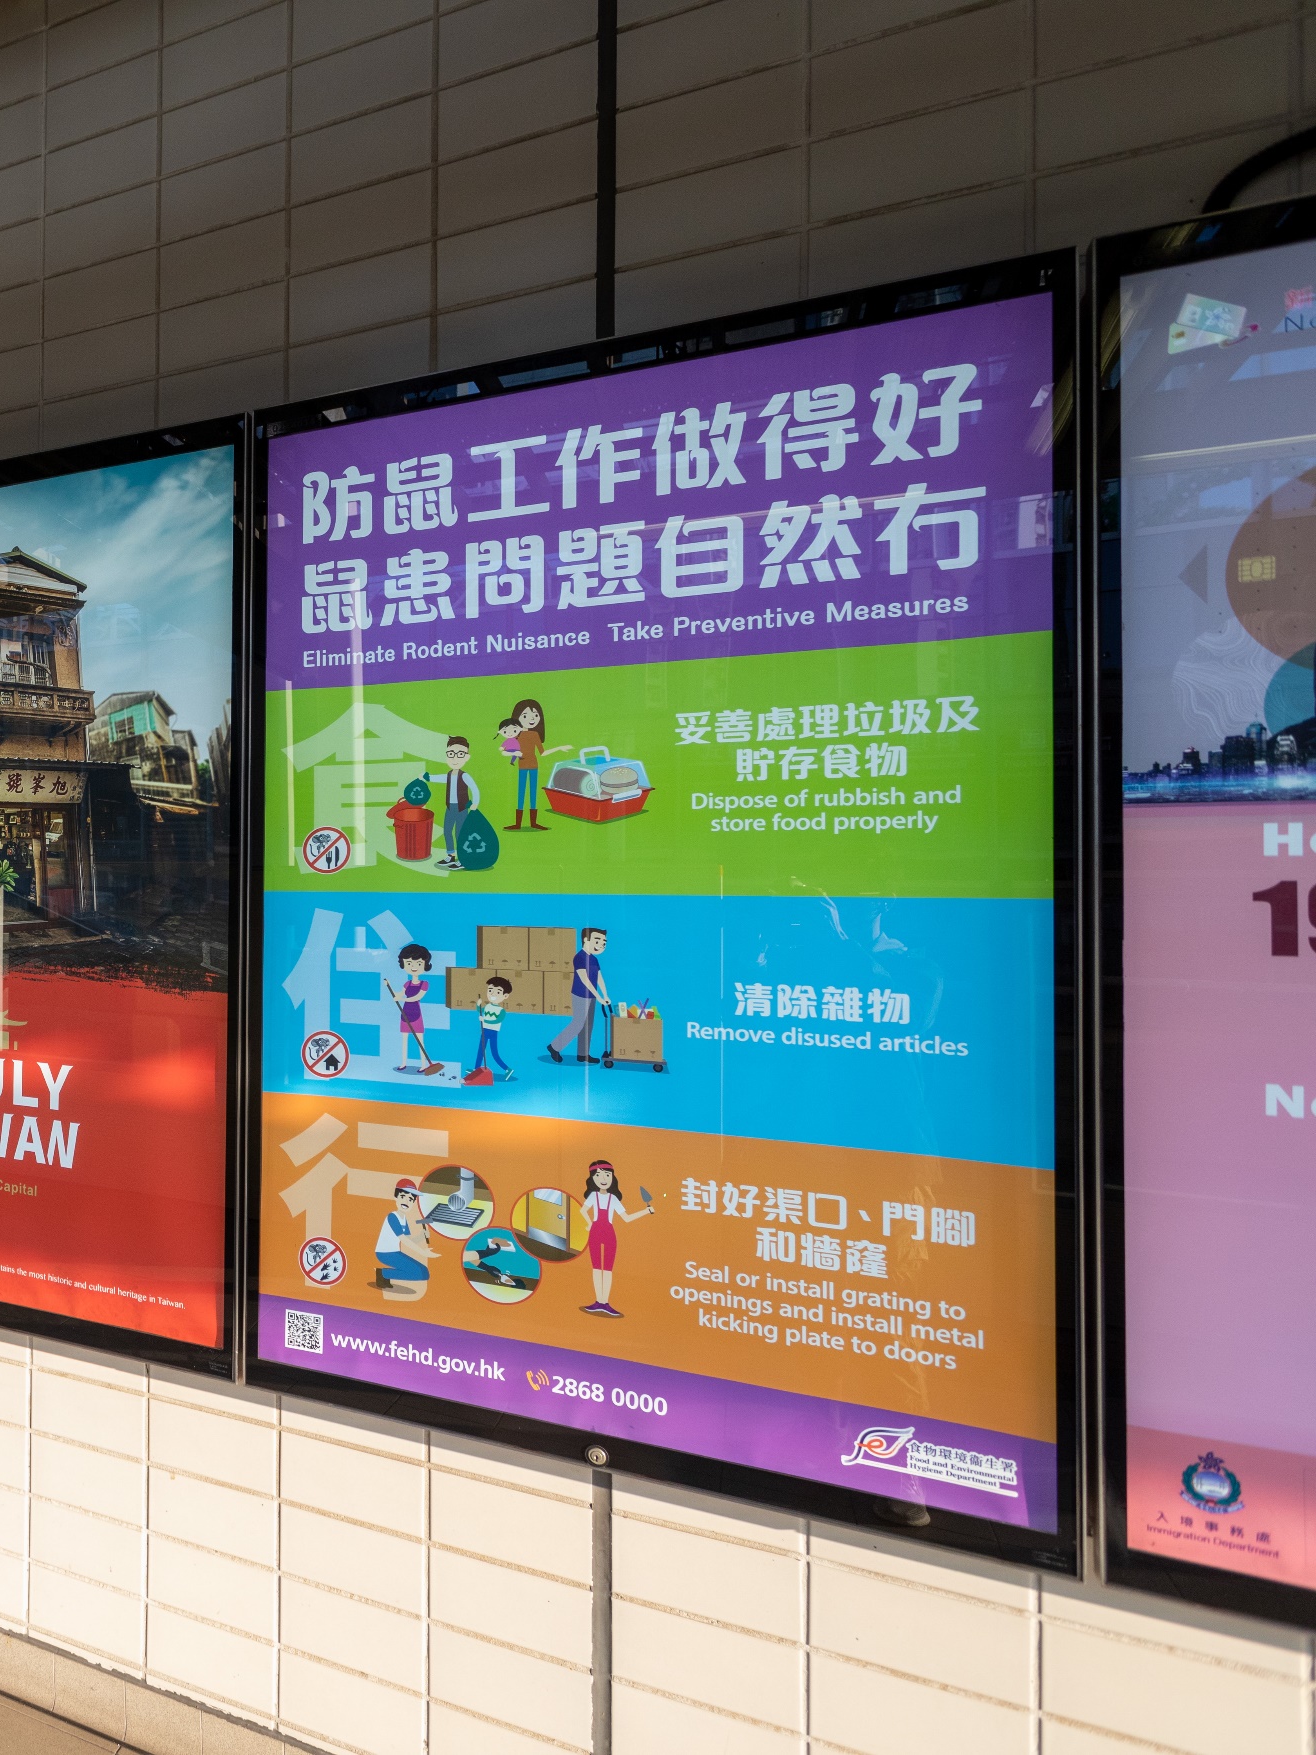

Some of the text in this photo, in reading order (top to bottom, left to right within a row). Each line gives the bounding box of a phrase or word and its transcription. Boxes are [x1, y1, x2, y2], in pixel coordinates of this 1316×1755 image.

[302, 363, 981, 545] 防鼠工作做得好
[301, 483, 987, 634] 鼠患問題自然冇
[302, 595, 969, 669] Eliminate Rodent Nuisance Take Preventive Measures
[675, 695, 980, 748] 妥善處理垃圾及
[735, 744, 907, 783] 貯存食物
[691, 785, 961, 814] Dispose of rubbish and
[711, 808, 939, 835] store food properly
[1252, 880, 1316, 957] 1
[282, 908, 461, 1089] 住
[734, 981, 911, 1027] 清除雜物
[686, 1022, 969, 1058] Remove disused articles
[278, 1112, 449, 1302] 行
[680, 1177, 975, 1248] 封好渠口、門腳
[17, 1267, 27, 1276] the
[29, 1272, 46, 1280] most
[48, 1273, 72, 1286] historic
[74, 1281, 86, 1289] and
[89, 1283, 115, 1295] cultural
[118, 1288, 147, 1302] heritage
[149, 1295, 156, 1303] in
[157, 1297, 185, 1309] Taiwan.
[684, 1260, 966, 1321] Seal or install grating to
[670, 1283, 984, 1349] openings and install metal
[698, 1308, 957, 1370] kicking plate to doors
[330, 1331, 505, 1383] www.fehd.gov.hk
[551, 1374, 668, 1417] 2868 0000
[910, 1455, 1014, 1483] Food and Environmental
[910, 1462, 997, 1487] Hygiene Department
[1146, 1524, 1279, 1559] Immigration Department
